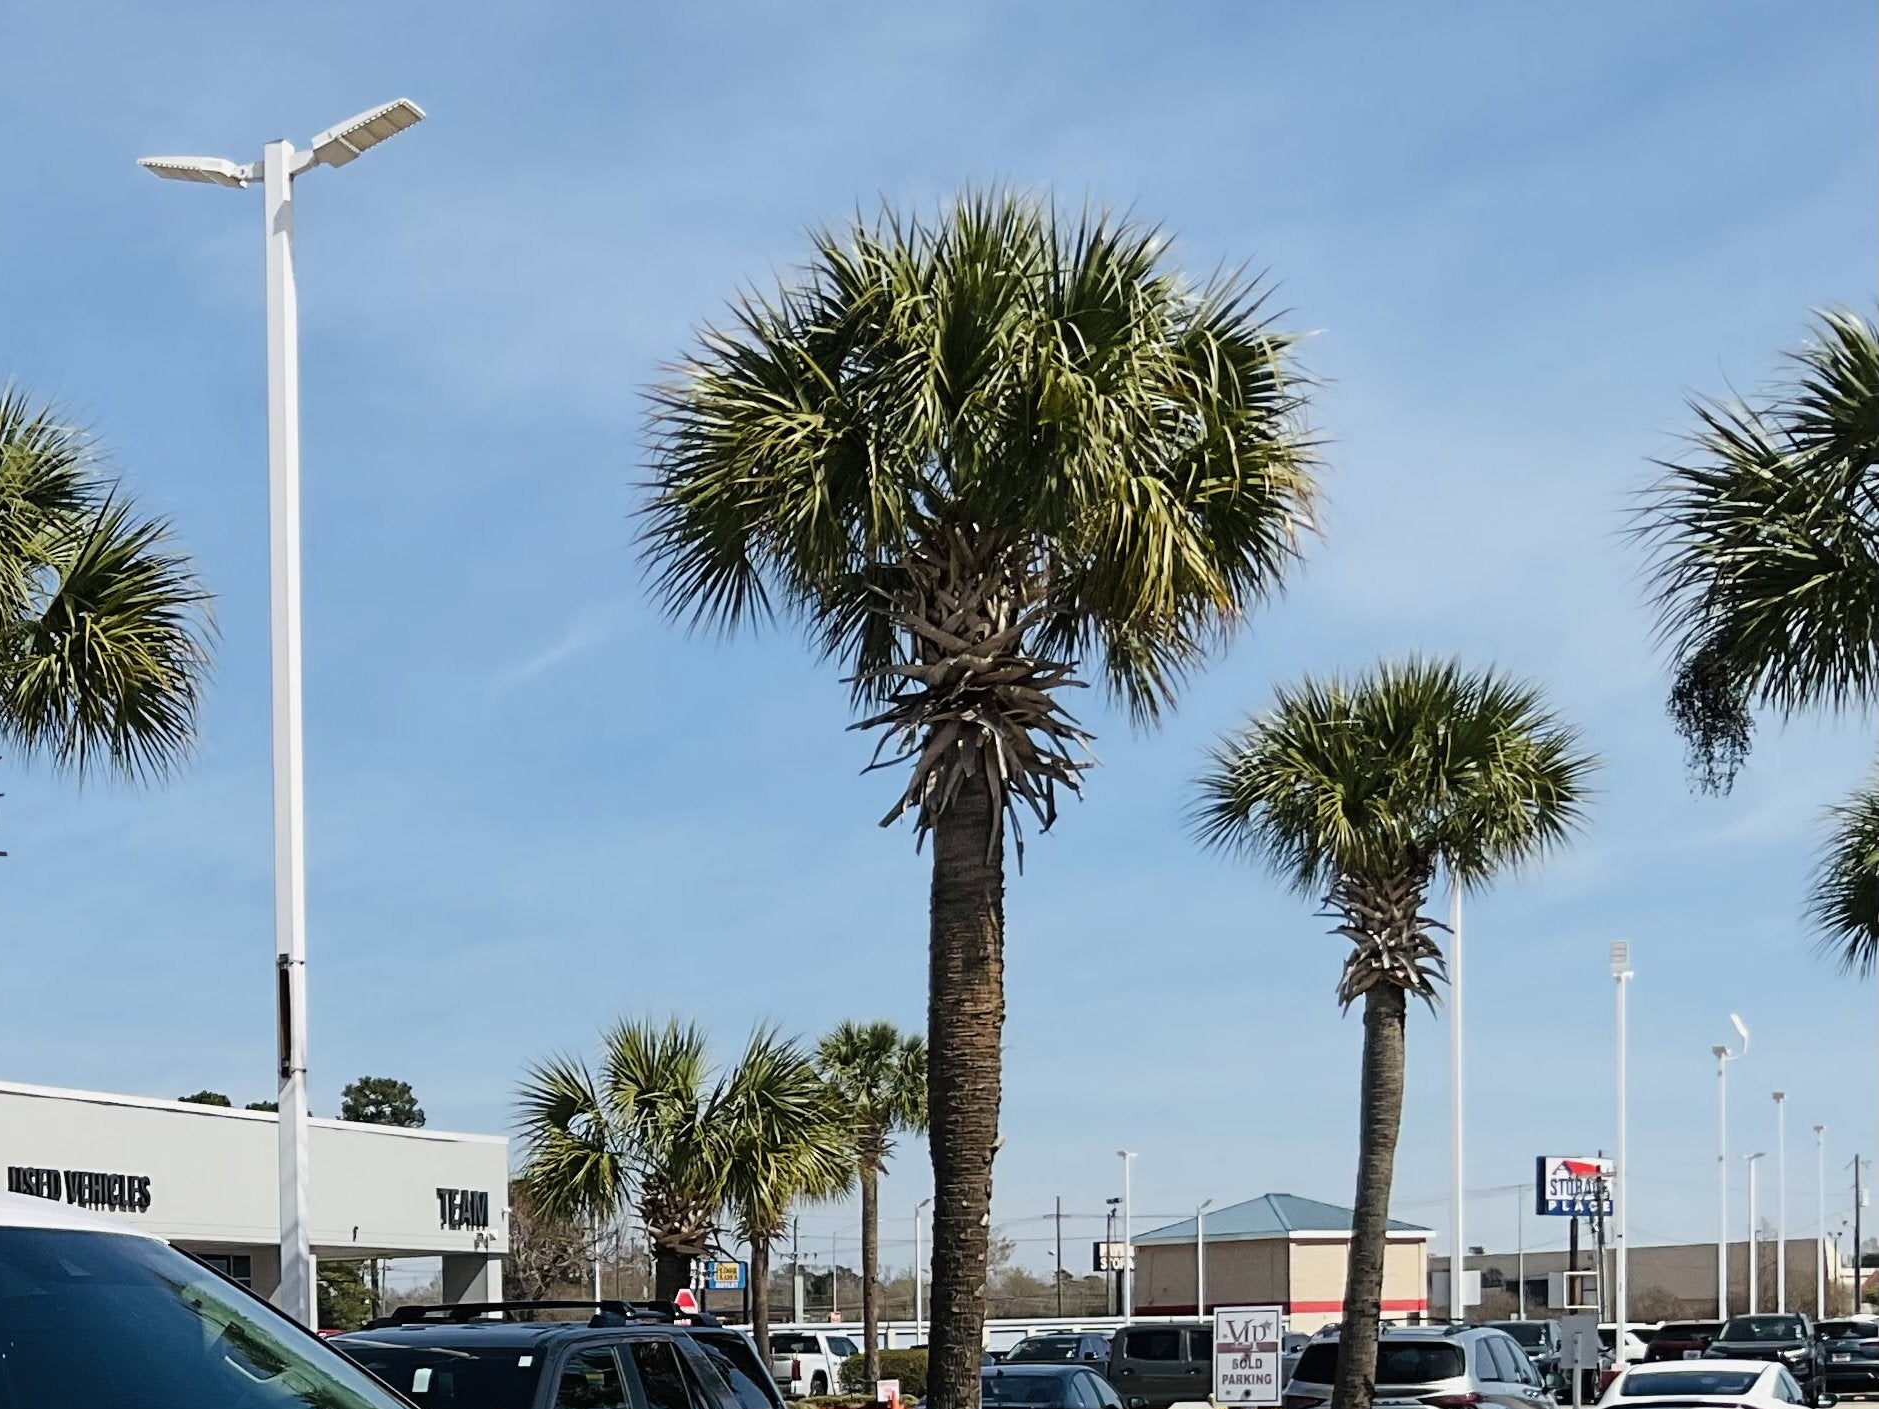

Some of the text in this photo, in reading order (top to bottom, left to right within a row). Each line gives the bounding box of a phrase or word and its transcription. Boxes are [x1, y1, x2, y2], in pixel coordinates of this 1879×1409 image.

[7, 1166, 151, 1211] USED VEHICLES
[435, 1187, 489, 1228] TEAM
[1547, 1200, 1611, 1212] PLACE
[1232, 1358, 1263, 1370] SOLD
[1221, 1373, 1273, 1386] PARKING
